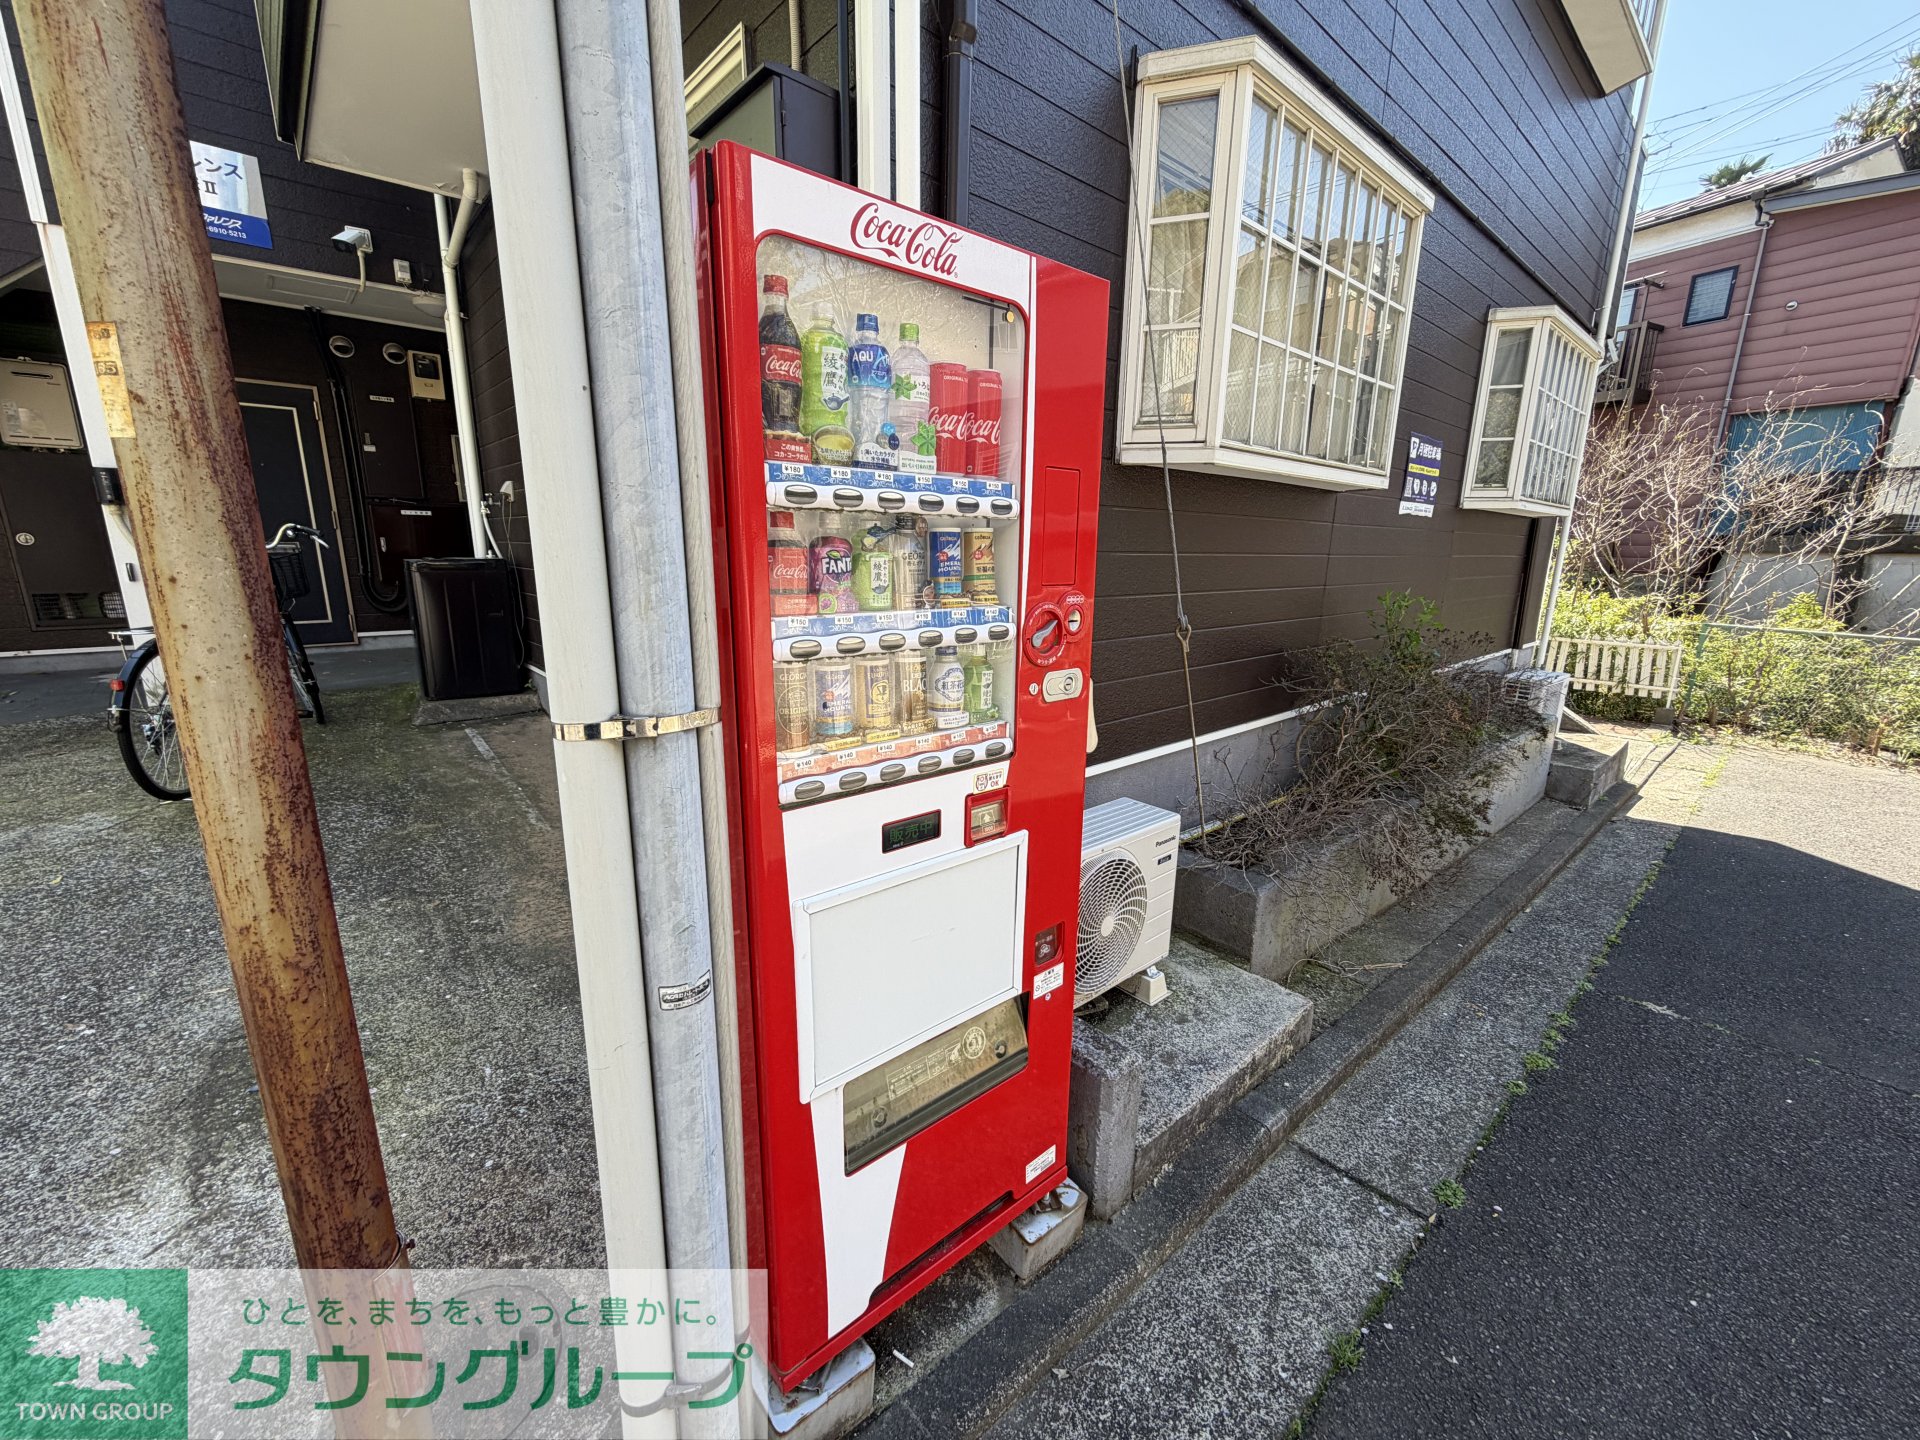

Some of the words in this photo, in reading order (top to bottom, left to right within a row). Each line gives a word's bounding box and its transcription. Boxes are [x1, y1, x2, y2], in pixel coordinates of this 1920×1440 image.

[194, 157, 243, 180] ンス
[850, 202, 963, 276] Coca-Cola
[990, 780, 1000, 788] OK
[889, 820, 933, 843] 販売中
